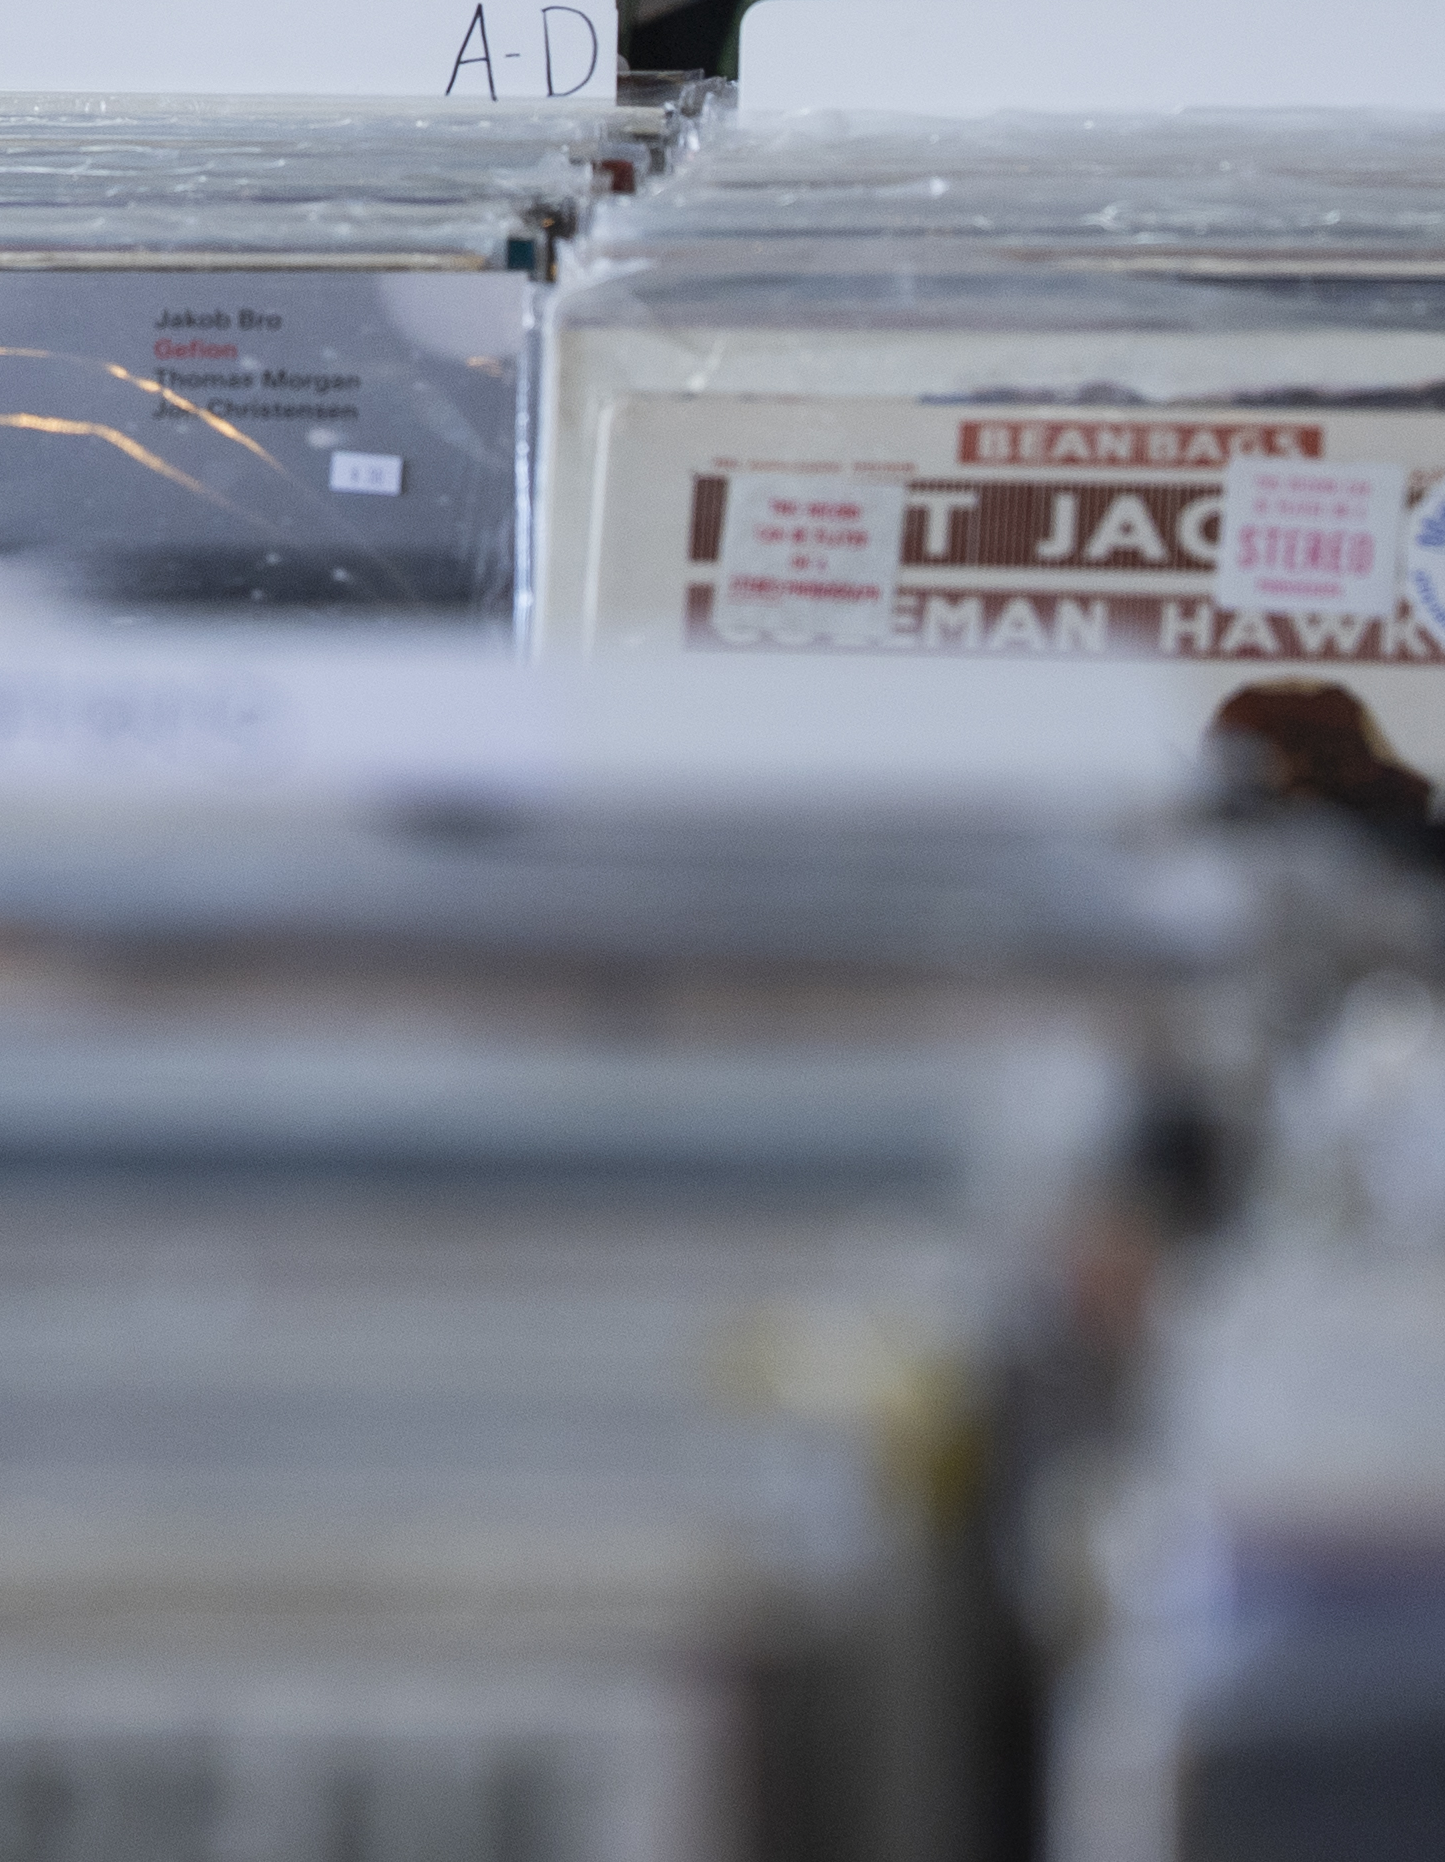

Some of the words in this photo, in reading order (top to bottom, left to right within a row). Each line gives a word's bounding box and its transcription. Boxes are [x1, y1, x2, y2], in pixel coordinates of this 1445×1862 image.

[445, 3, 598, 101] A-D
[154, 309, 231, 331] Jakob
[237, 309, 282, 331] Bro
[154, 339, 238, 360] Gefion
[156, 369, 253, 390] Thomas
[262, 369, 360, 395] Morgan
[208, 399, 359, 421] Christensen
